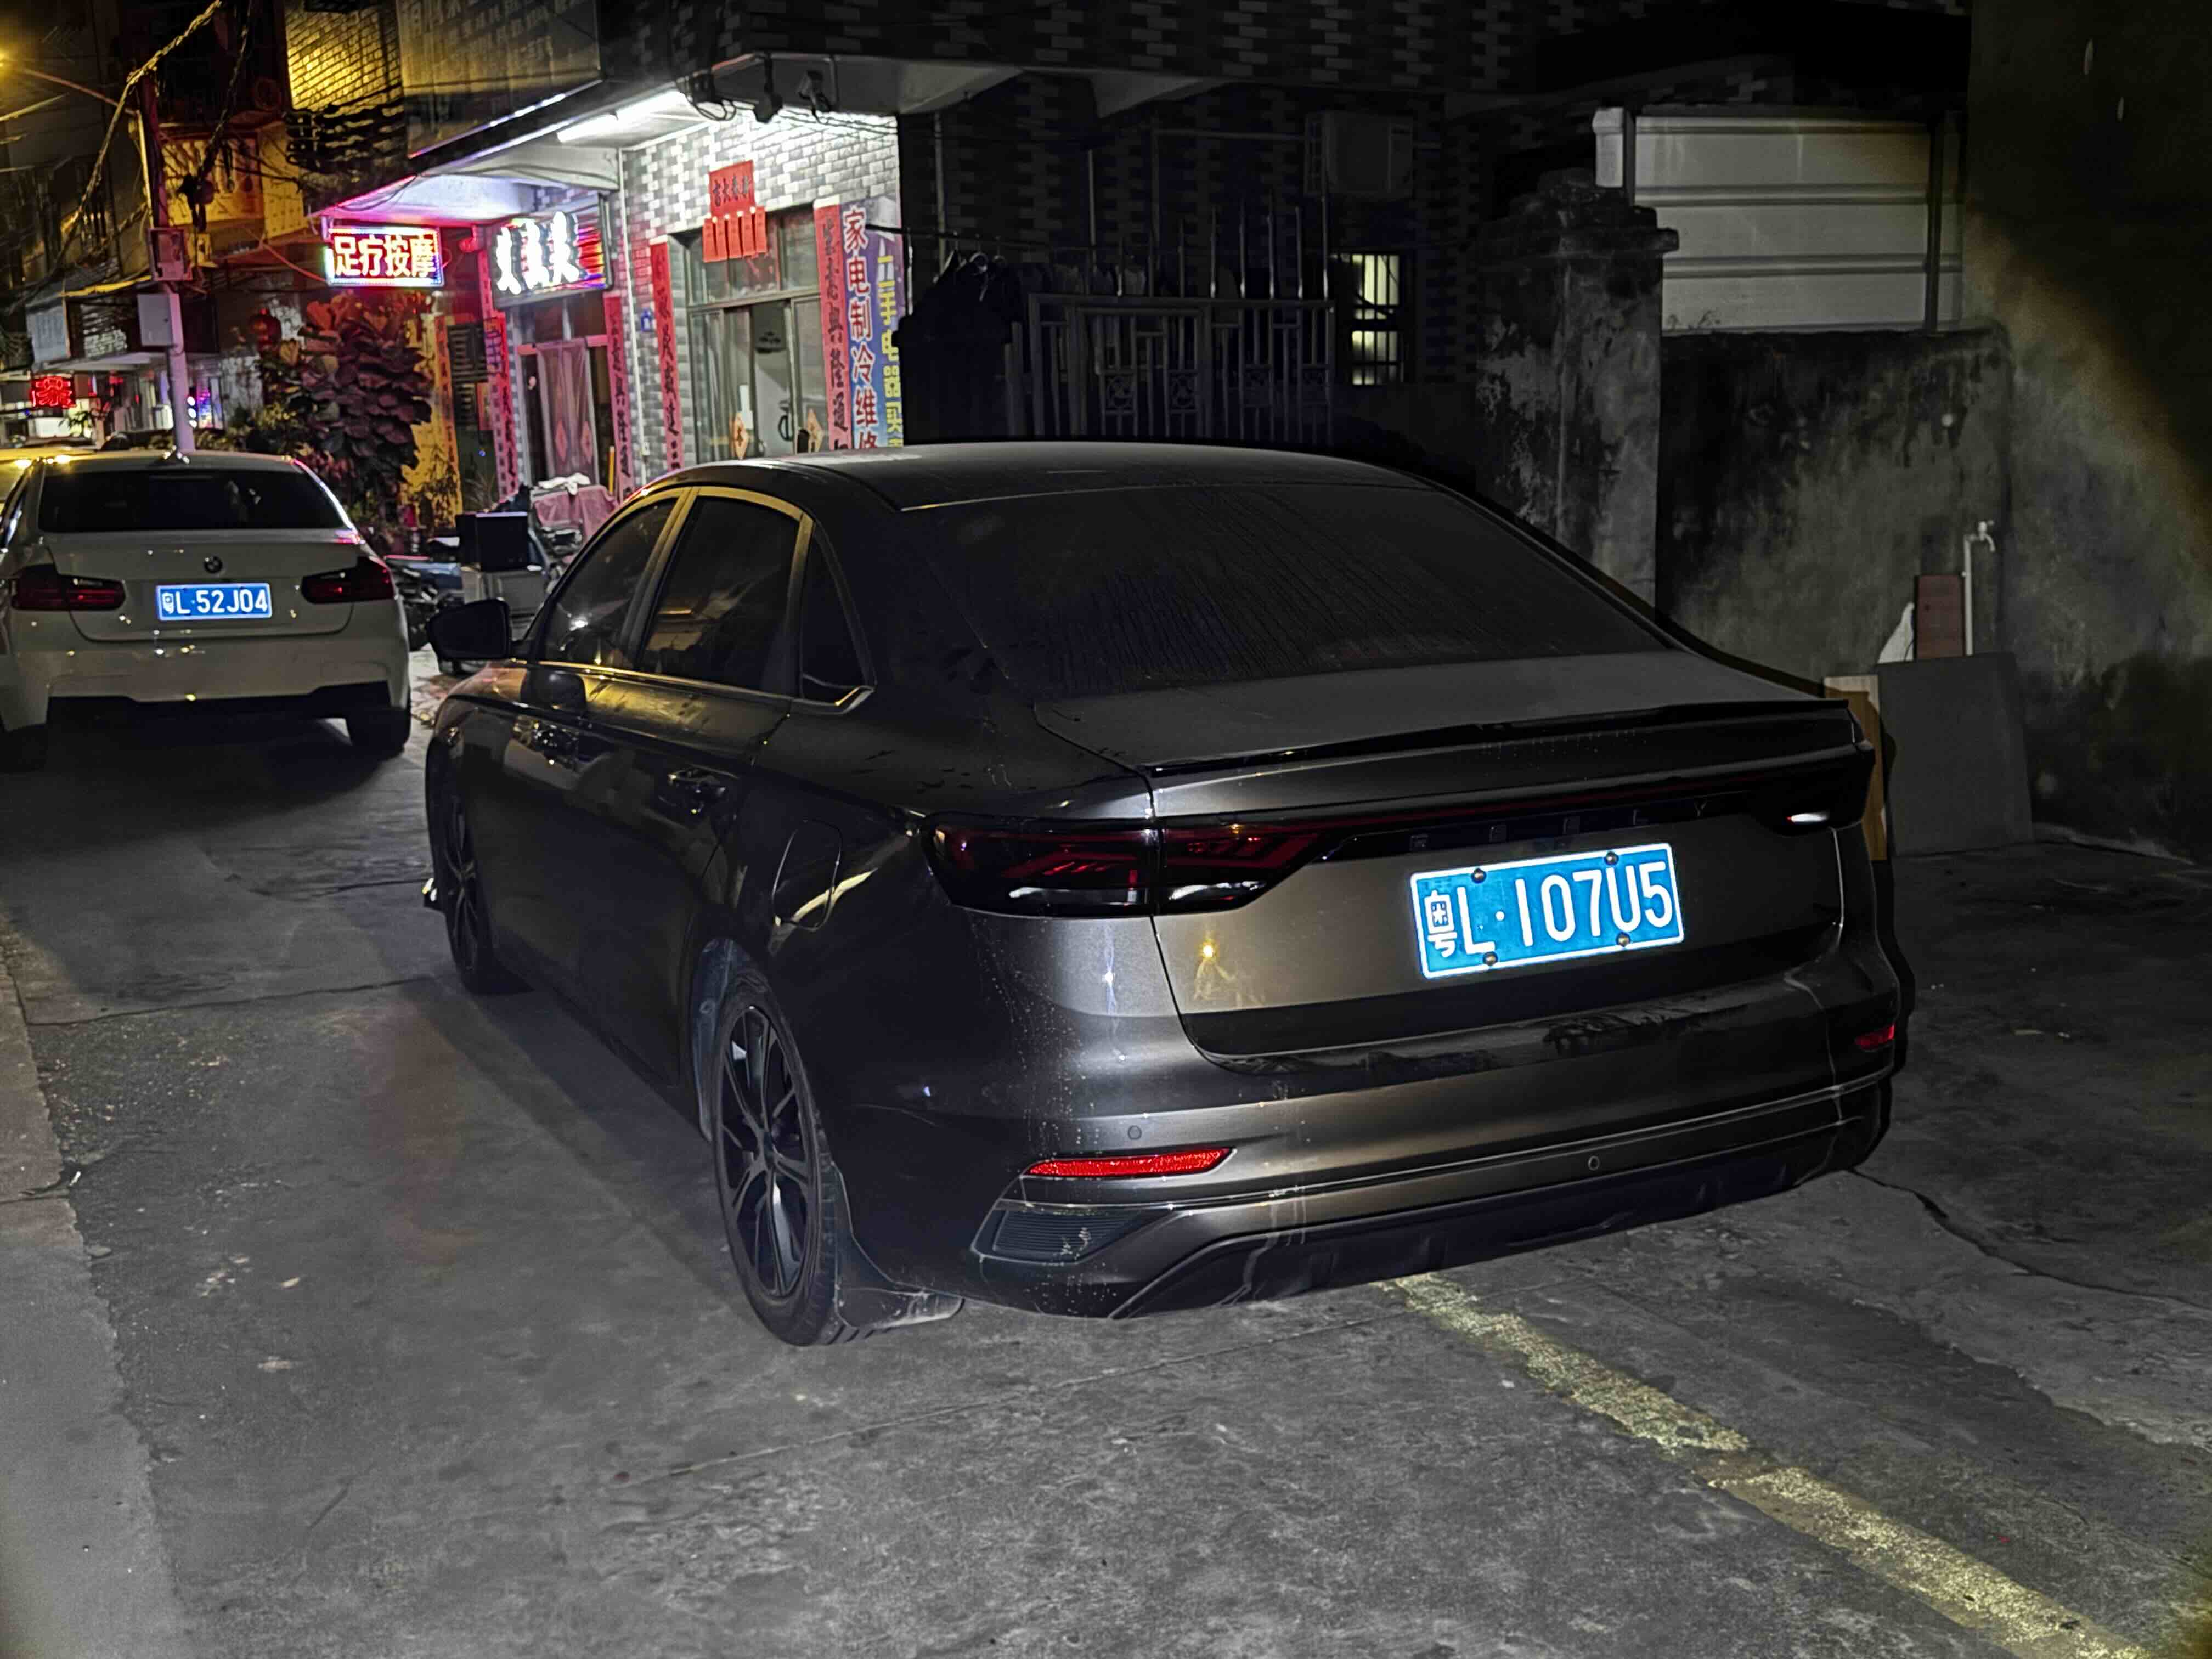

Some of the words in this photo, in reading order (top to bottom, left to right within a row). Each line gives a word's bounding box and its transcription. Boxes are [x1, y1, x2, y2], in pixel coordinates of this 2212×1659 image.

[334, 234, 436, 277] 足疗按摩
[877, 255, 904, 448] 二手电器买
